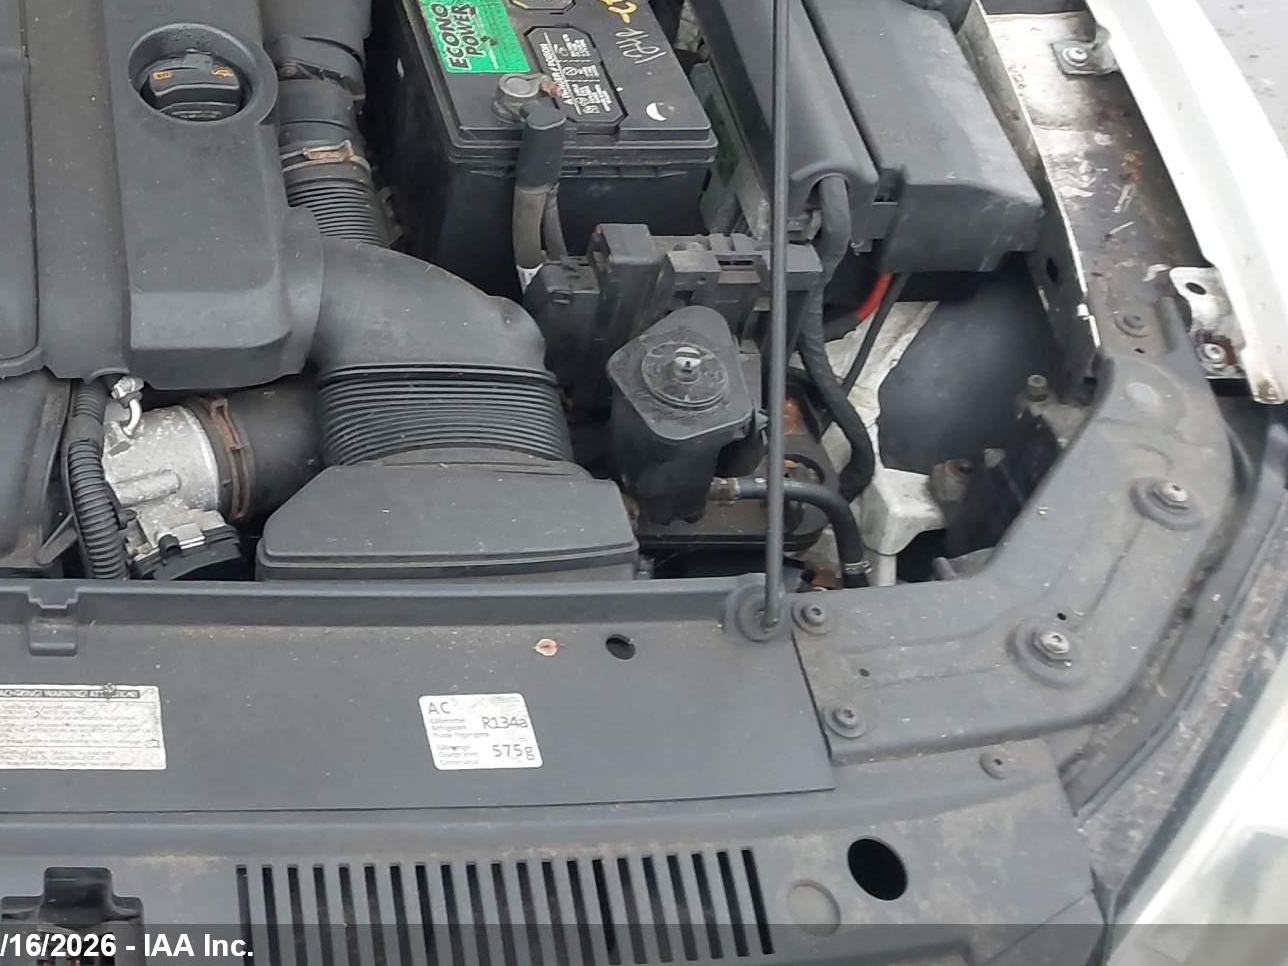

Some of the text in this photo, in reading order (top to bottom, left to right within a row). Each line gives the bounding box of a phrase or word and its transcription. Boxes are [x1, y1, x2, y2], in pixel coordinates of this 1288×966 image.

[431, 3, 469, 69] ECONO
[452, 5, 484, 56] POWER
[428, 701, 452, 715] AC
[481, 716, 529, 729] R134a
